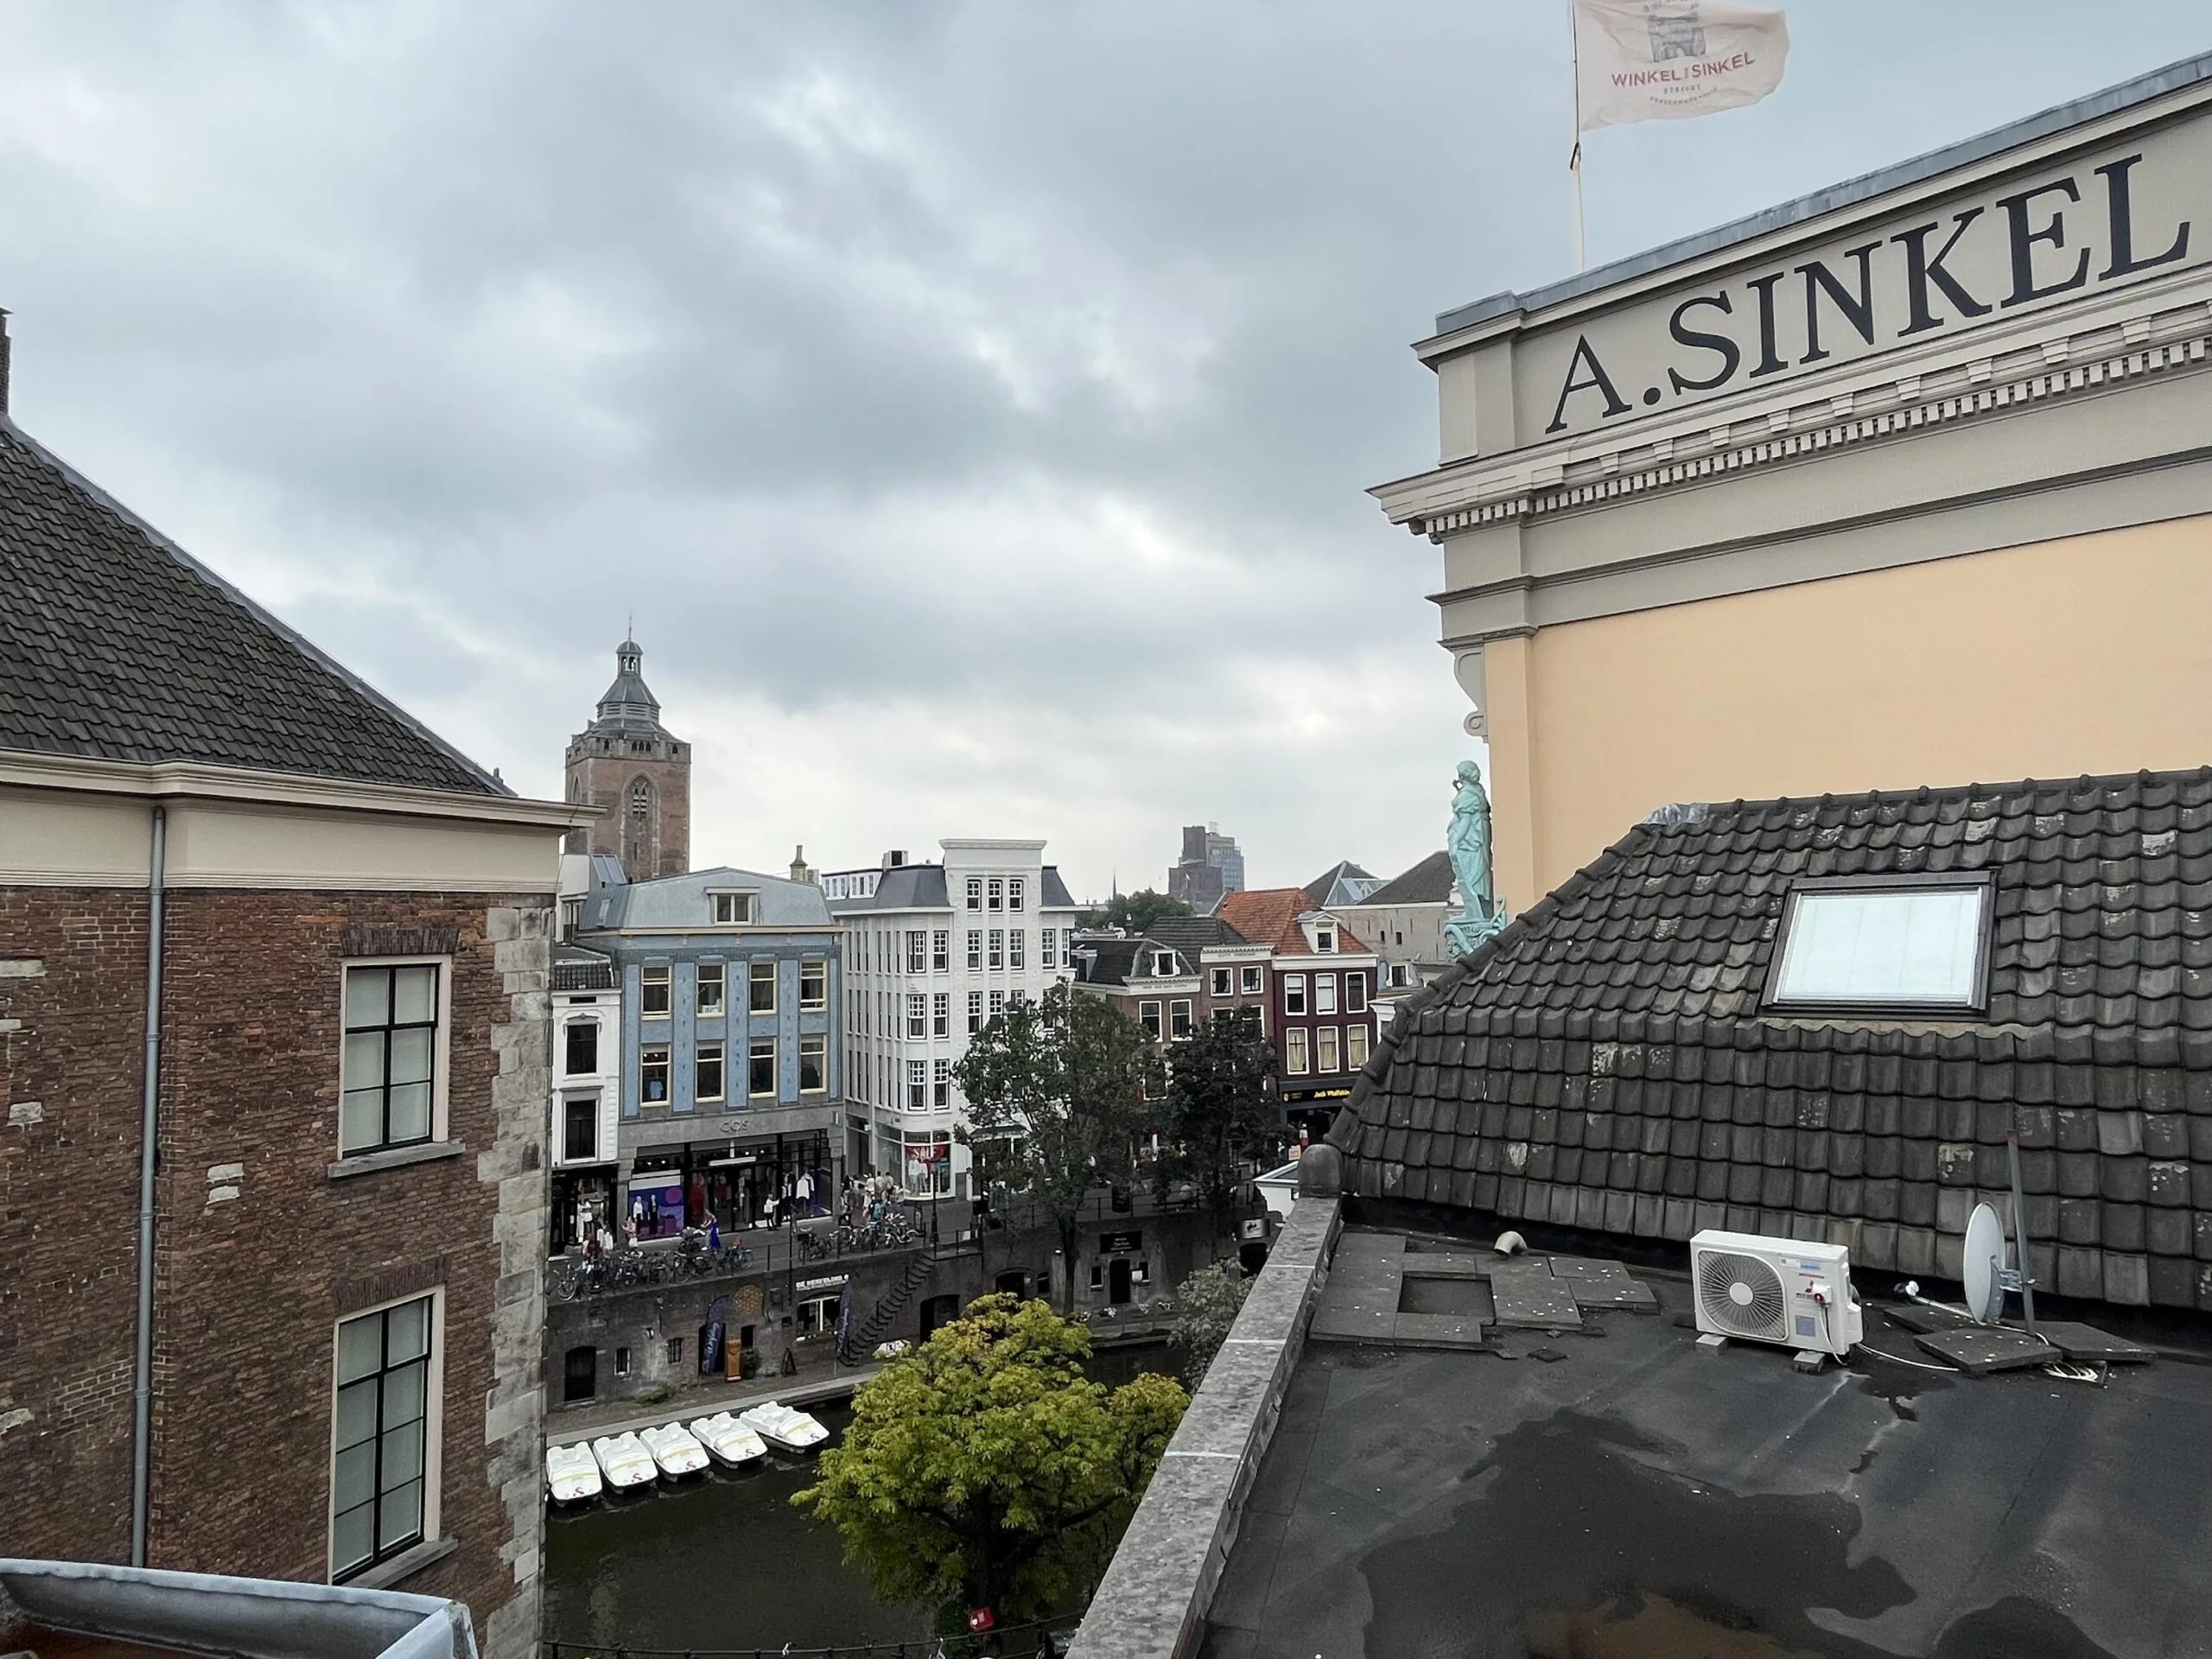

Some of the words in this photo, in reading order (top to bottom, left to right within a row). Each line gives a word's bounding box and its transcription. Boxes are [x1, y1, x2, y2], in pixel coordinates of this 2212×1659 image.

[1611, 69, 1681, 86] WINKEL
[1692, 52, 1755, 78] SINKEL
[720, 1120, 748, 1133] COS
